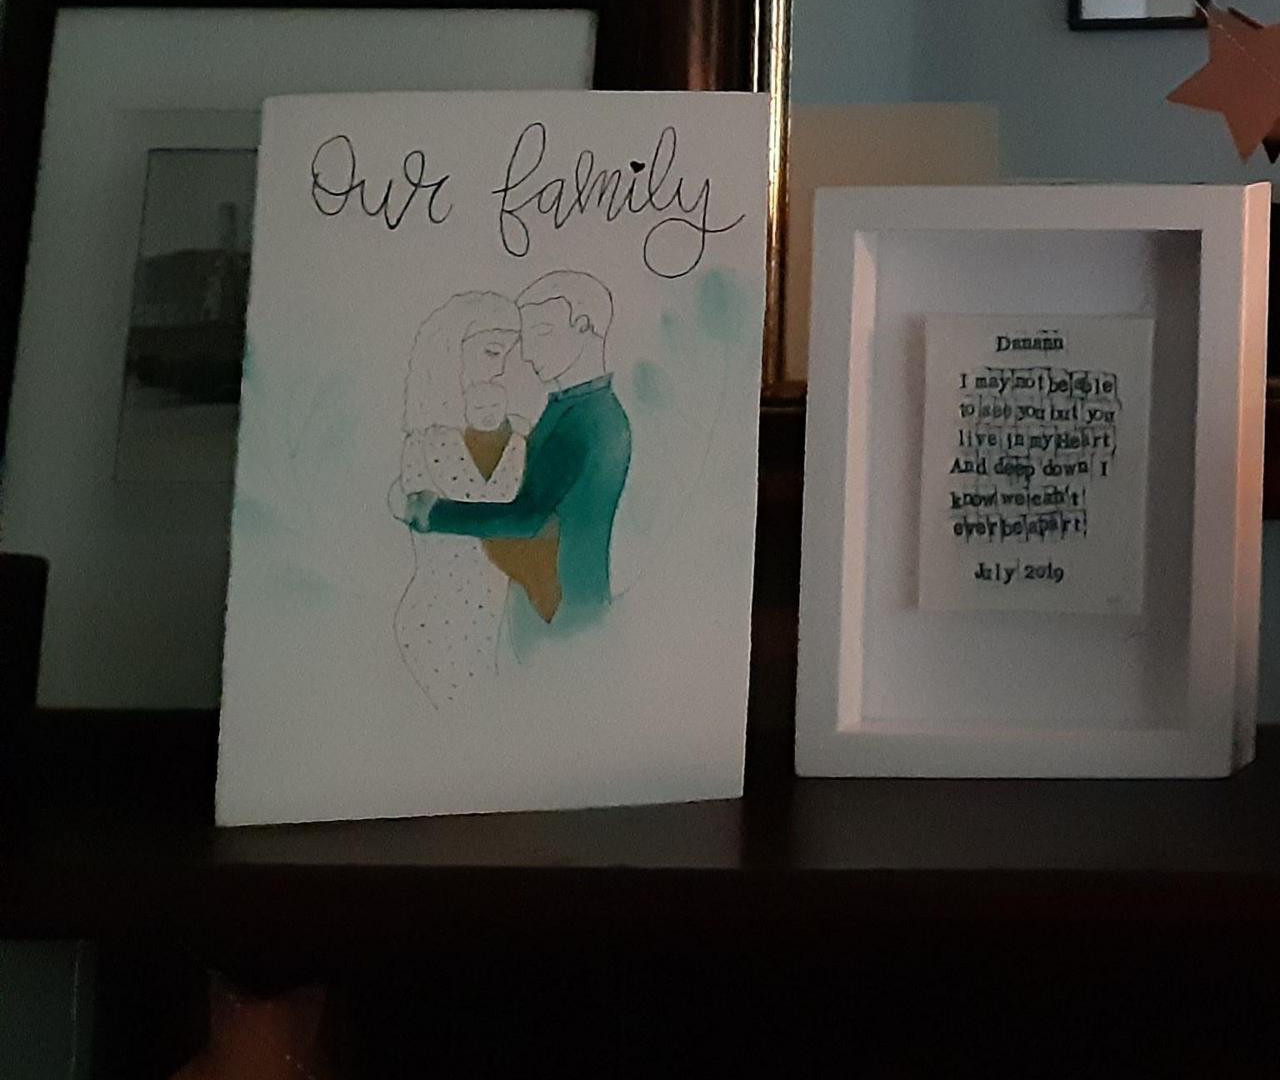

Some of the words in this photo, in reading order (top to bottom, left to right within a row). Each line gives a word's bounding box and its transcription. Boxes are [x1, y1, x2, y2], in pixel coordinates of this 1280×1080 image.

[311, 135, 453, 230] Our
[492, 122, 746, 278] family
[996, 336, 1065, 352] Danann
[959, 373, 968, 389] I
[975, 375, 1010, 395] may
[1013, 374, 1044, 391] not
[1048, 375, 1070, 393] be
[959, 402, 976, 418] to
[982, 403, 1013, 419] see
[1017, 404, 1045, 421] you
[1051, 403, 1078, 421] but
[1087, 407, 1116, 424] you
[958, 429, 998, 447] live
[1007, 432, 1025, 450] in
[1030, 433, 1054, 451] my
[950, 457, 989, 475] And
[994, 457, 1036, 481] deep
[1042, 458, 1090, 476] down
[1099, 461, 1109, 477] I
[950, 491, 998, 509] know
[1001, 492, 1025, 507] we
[1030, 486, 1079, 507] can't
[953, 519, 997, 537] ever
[1001, 518, 1024, 537] be
[974, 562, 1016, 585] July
[1024, 562, 1065, 583] 2019
